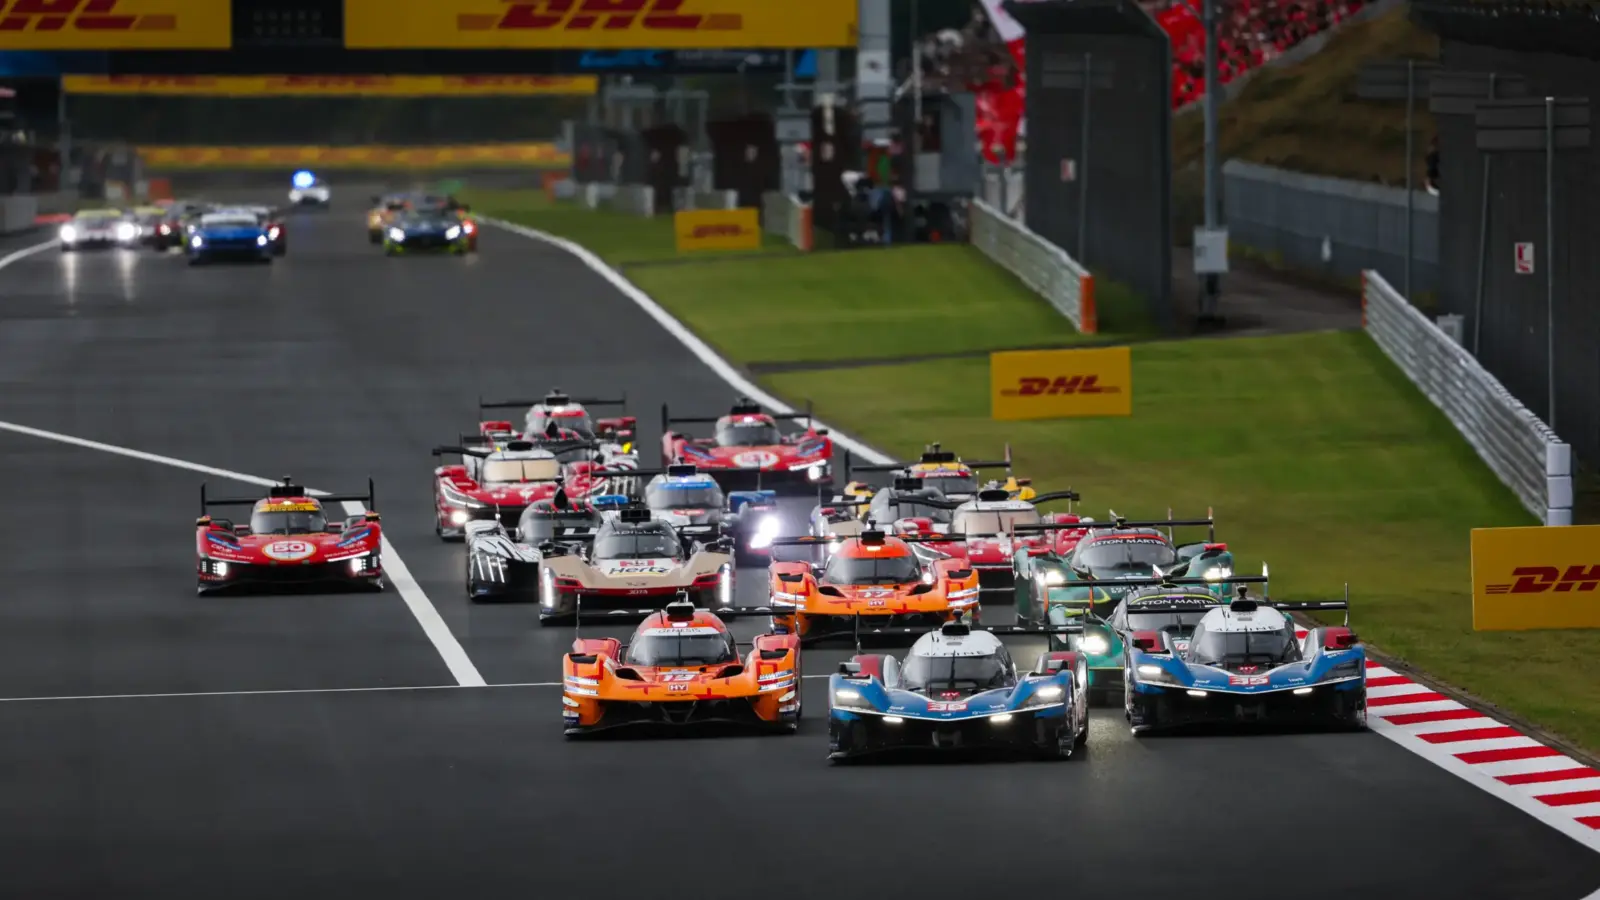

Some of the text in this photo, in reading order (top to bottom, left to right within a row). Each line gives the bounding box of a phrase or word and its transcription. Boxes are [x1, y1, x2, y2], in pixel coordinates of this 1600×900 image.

[0, 0, 137, 30] HL
[498, 0, 703, 29] DHL
[1019, 375, 1103, 396] DHL
[272, 543, 305, 552] 50
[1090, 538, 1167, 548] ASTON MARTIN
[609, 567, 668, 575] Hertz
[669, 685, 687, 693] HY
